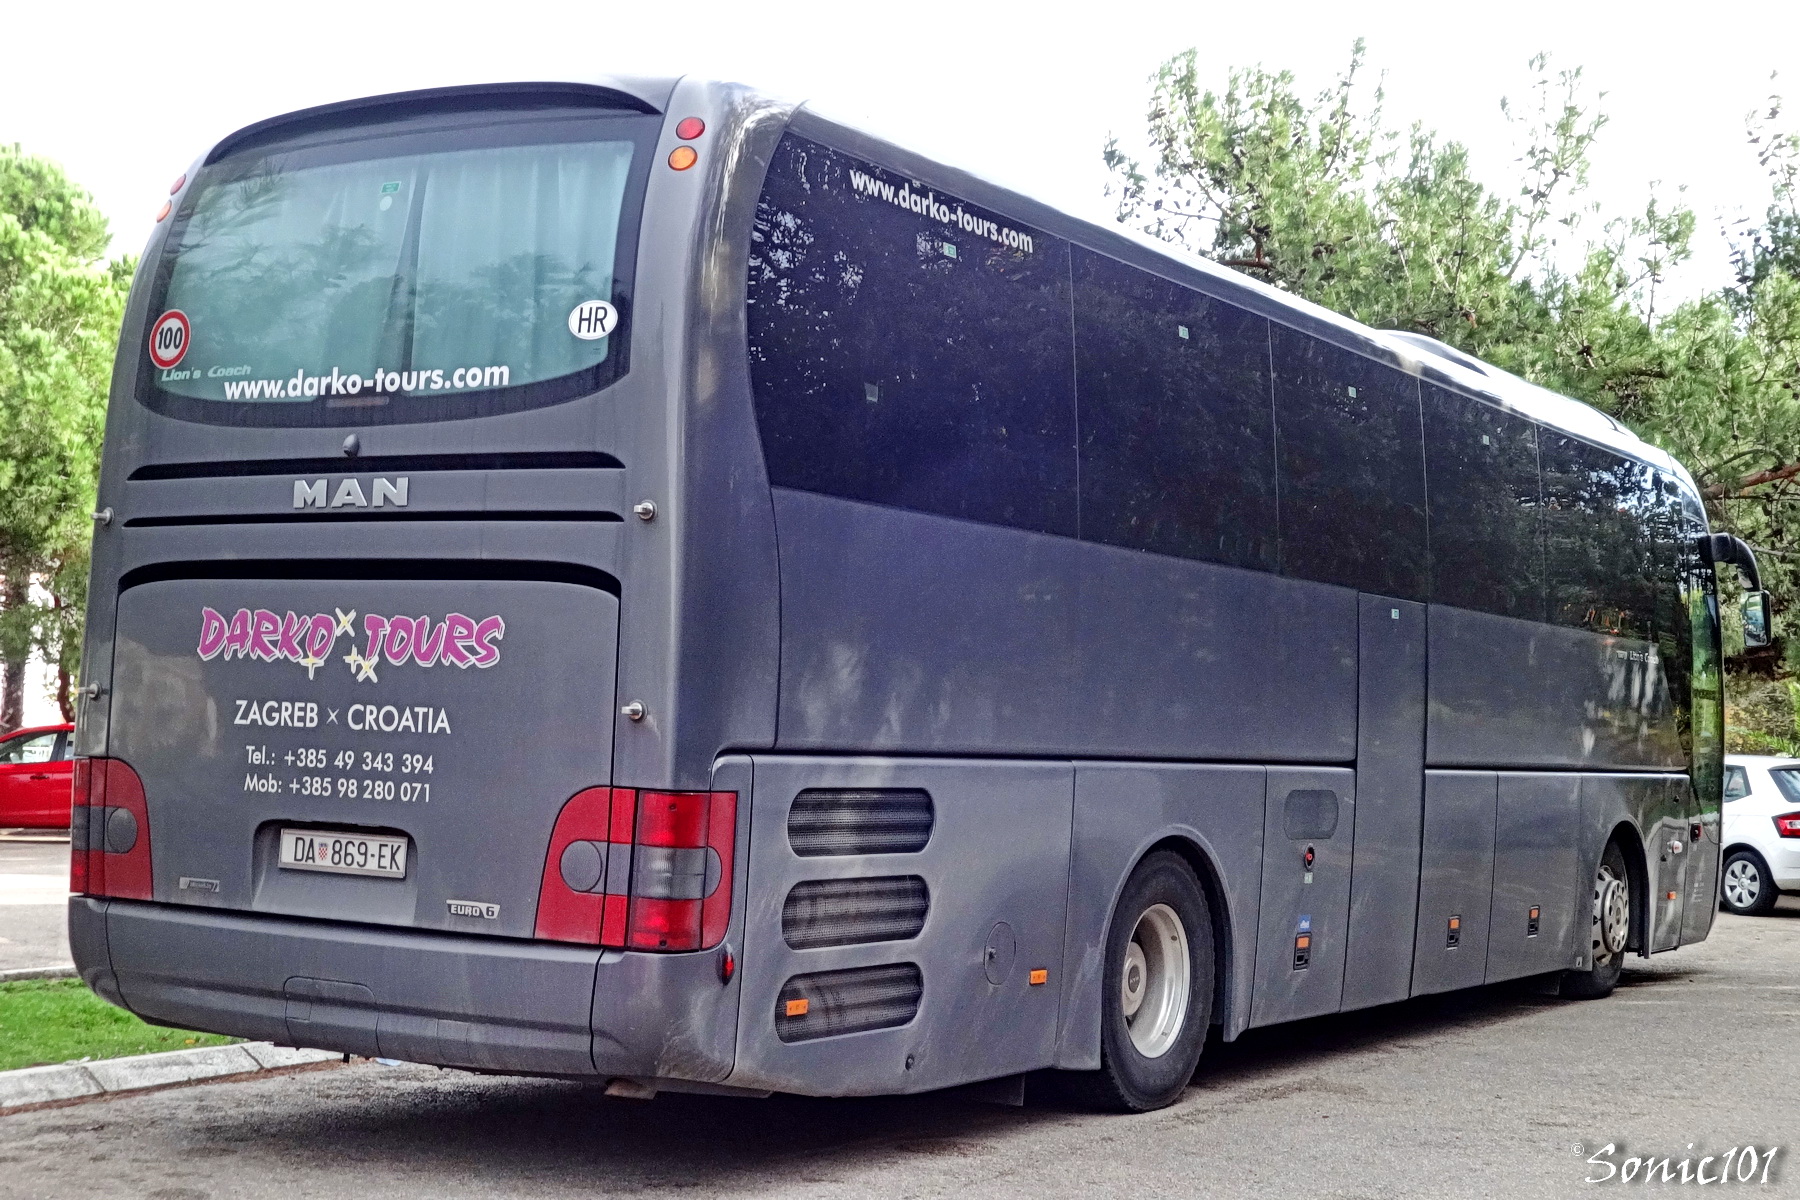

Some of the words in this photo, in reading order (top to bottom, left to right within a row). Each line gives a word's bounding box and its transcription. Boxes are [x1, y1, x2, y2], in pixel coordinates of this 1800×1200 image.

[850, 168, 1034, 254] www.darko-tours.com
[577, 306, 608, 334] HR
[157, 326, 184, 350] 100
[161, 367, 202, 382] Lion's
[207, 364, 252, 378] Coach
[223, 364, 510, 400] www.darko-tours.com
[292, 476, 410, 509] MAN
[198, 606, 338, 662] DARKO
[364, 612, 505, 669] TOURS
[234, 699, 319, 728] ZAGREB
[347, 703, 452, 735] CROATIA
[245, 745, 275, 766] Tel.:
[284, 748, 327, 769] +385
[334, 750, 355, 771] 49
[361, 751, 394, 773] 343
[401, 753, 434, 775] 394
[243, 773, 282, 794] Mob:
[289, 776, 332, 797] +385
[337, 777, 358, 799] 98
[362, 779, 395, 801] 280
[400, 781, 431, 803] 071
[293, 836, 316, 864] DA
[331, 839, 402, 871] 869-EK
[450, 904, 480, 917] EURO
[485, 905, 495, 918] 6
